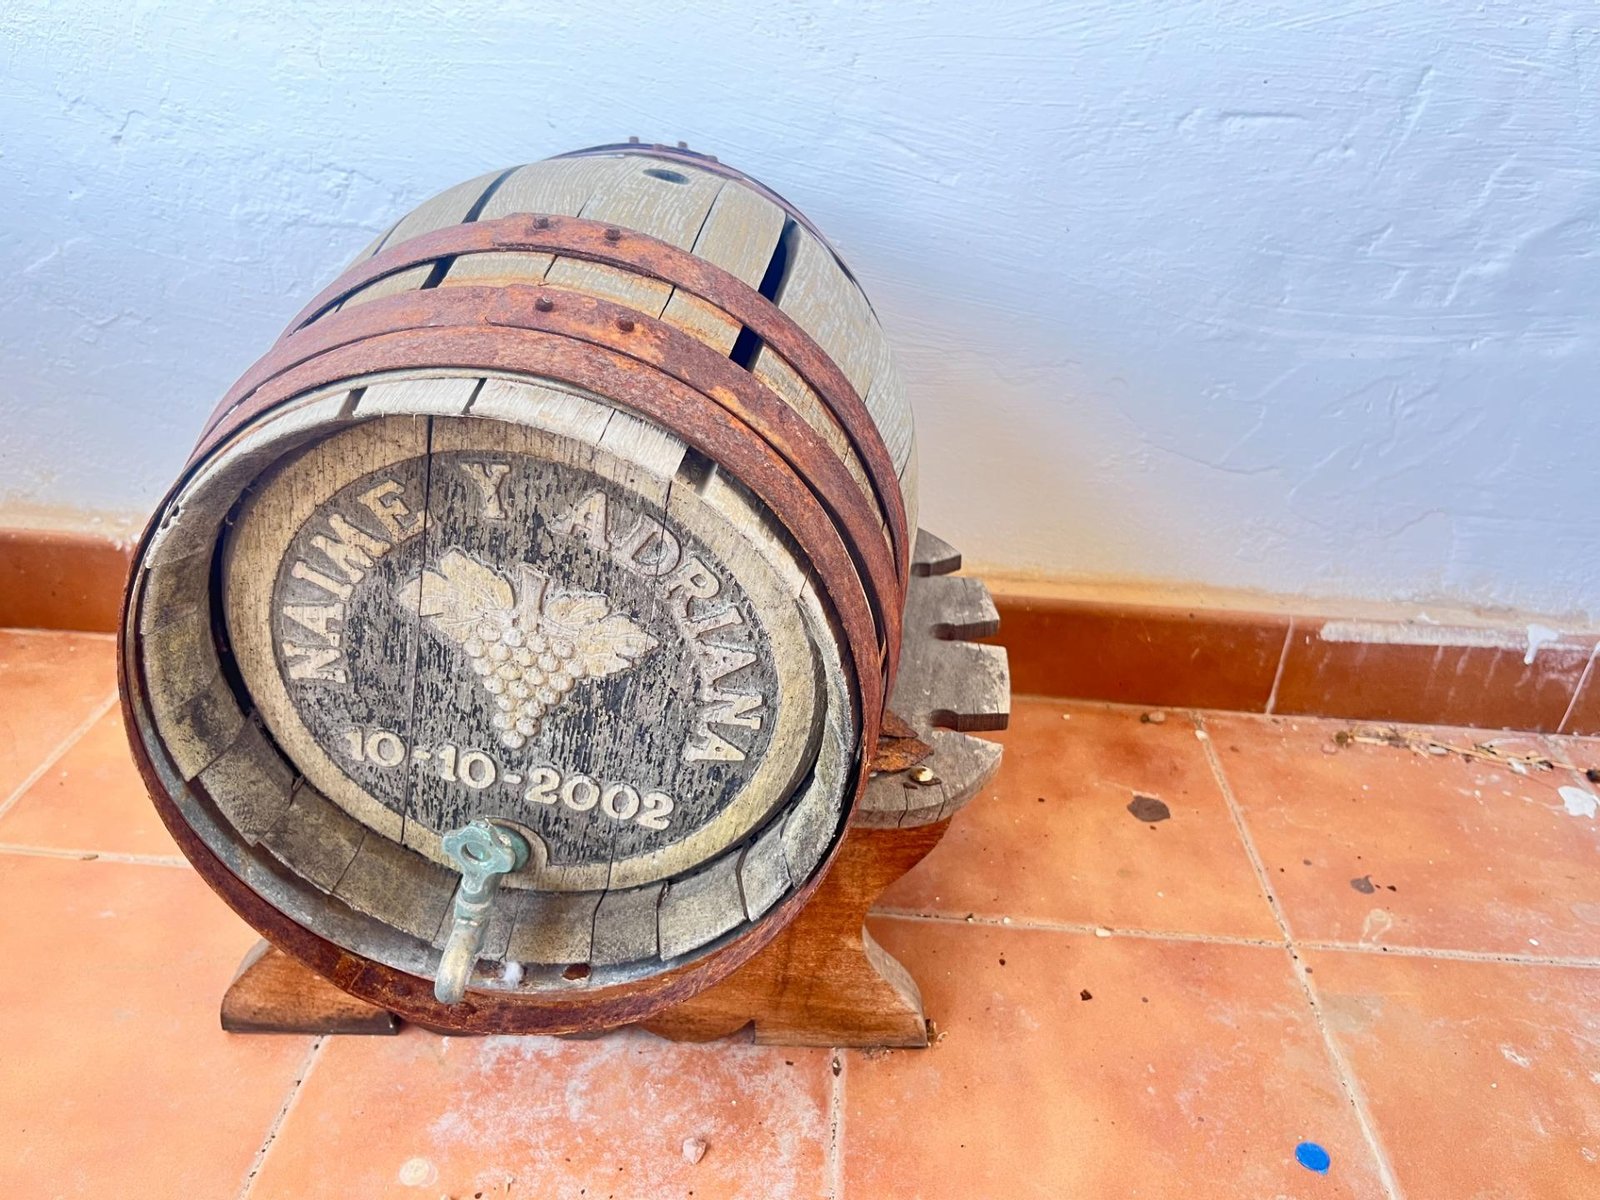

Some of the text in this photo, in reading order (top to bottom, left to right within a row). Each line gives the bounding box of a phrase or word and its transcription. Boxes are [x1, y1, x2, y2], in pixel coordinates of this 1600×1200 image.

[283, 462, 763, 763] NAIME Y ADRIANA
[343, 727, 675, 832] 10-10-2002
